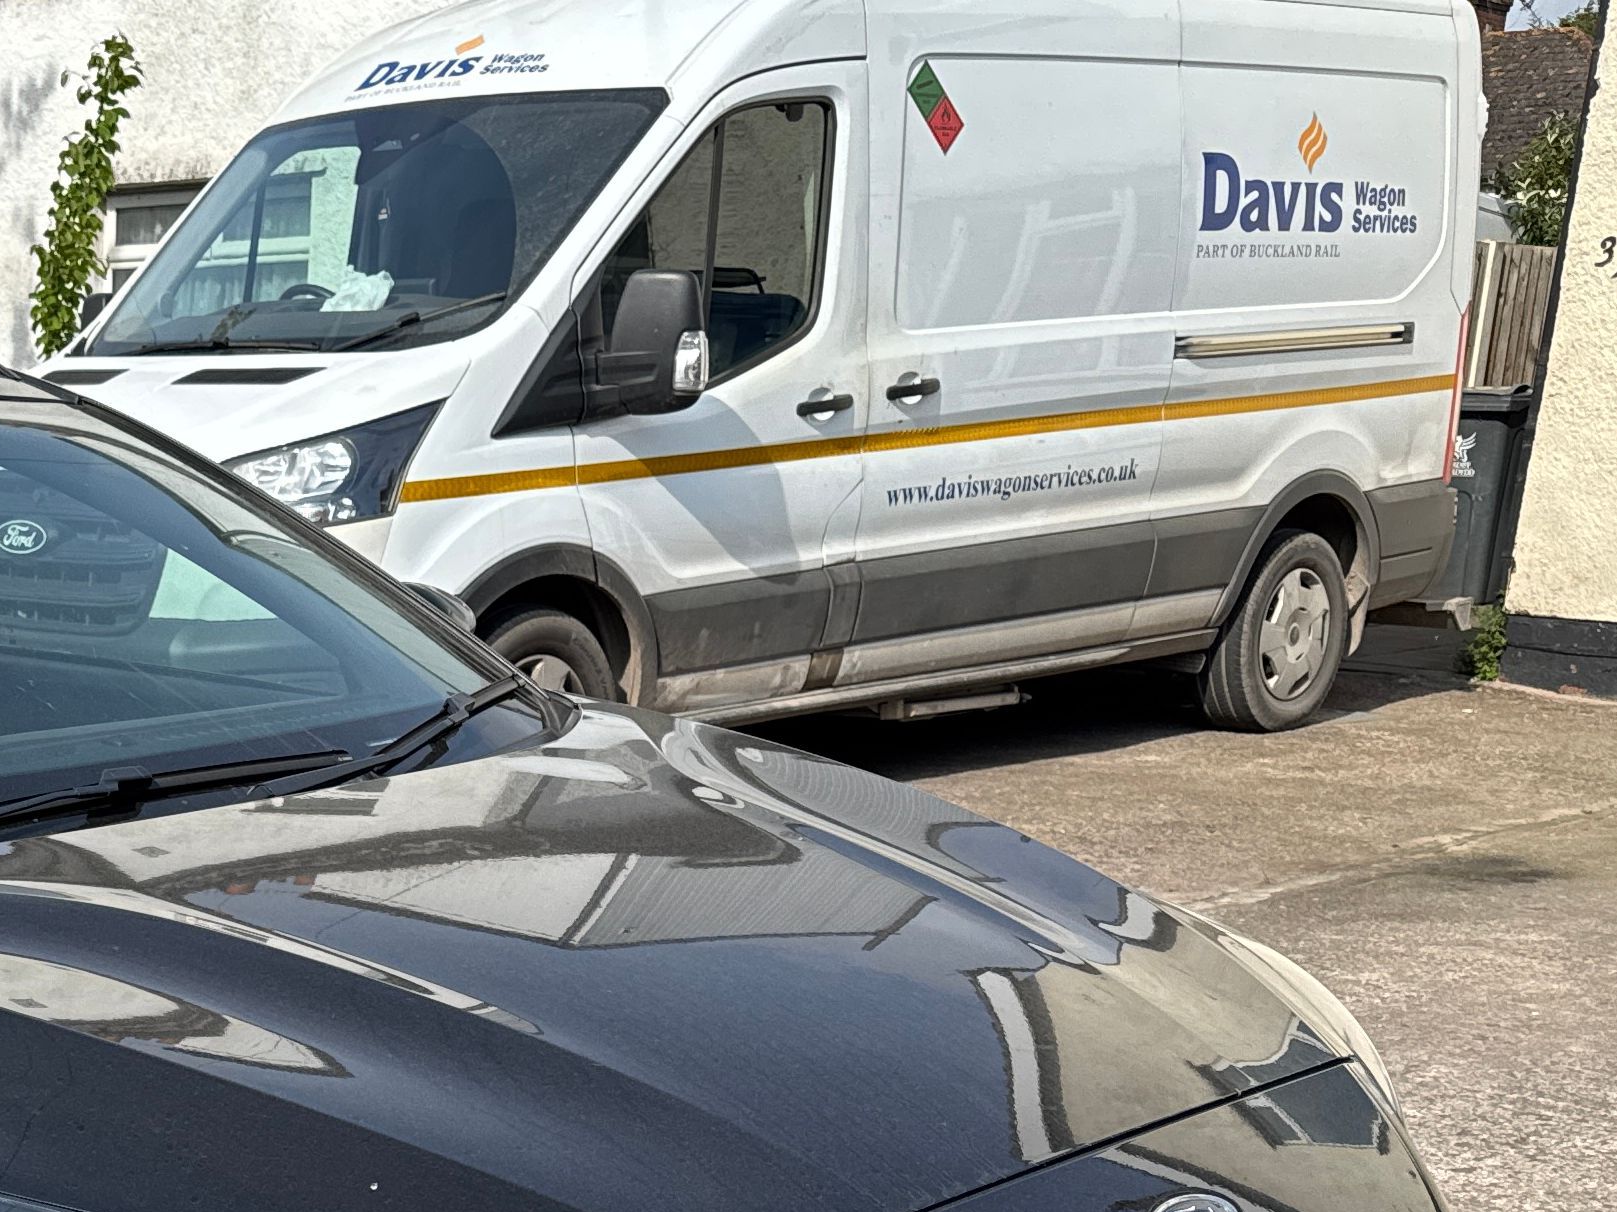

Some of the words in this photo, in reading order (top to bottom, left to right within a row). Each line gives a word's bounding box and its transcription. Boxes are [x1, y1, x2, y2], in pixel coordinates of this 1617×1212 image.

[353, 56, 484, 92] Davis
[491, 53, 545, 65] Wagon
[479, 63, 550, 75] Services
[1199, 152, 1343, 232] Davis
[1354, 181, 1406, 211] Wagon
[1352, 208, 1417, 233] Services
[1196, 244, 1228, 259] PART
[1230, 244, 1247, 258] OF
[1249, 244, 1312, 258] BUCKLAND
[1314, 244, 1341, 257] RAIL
[887, 458, 1139, 507] www.daviswagonservices.co.uk
